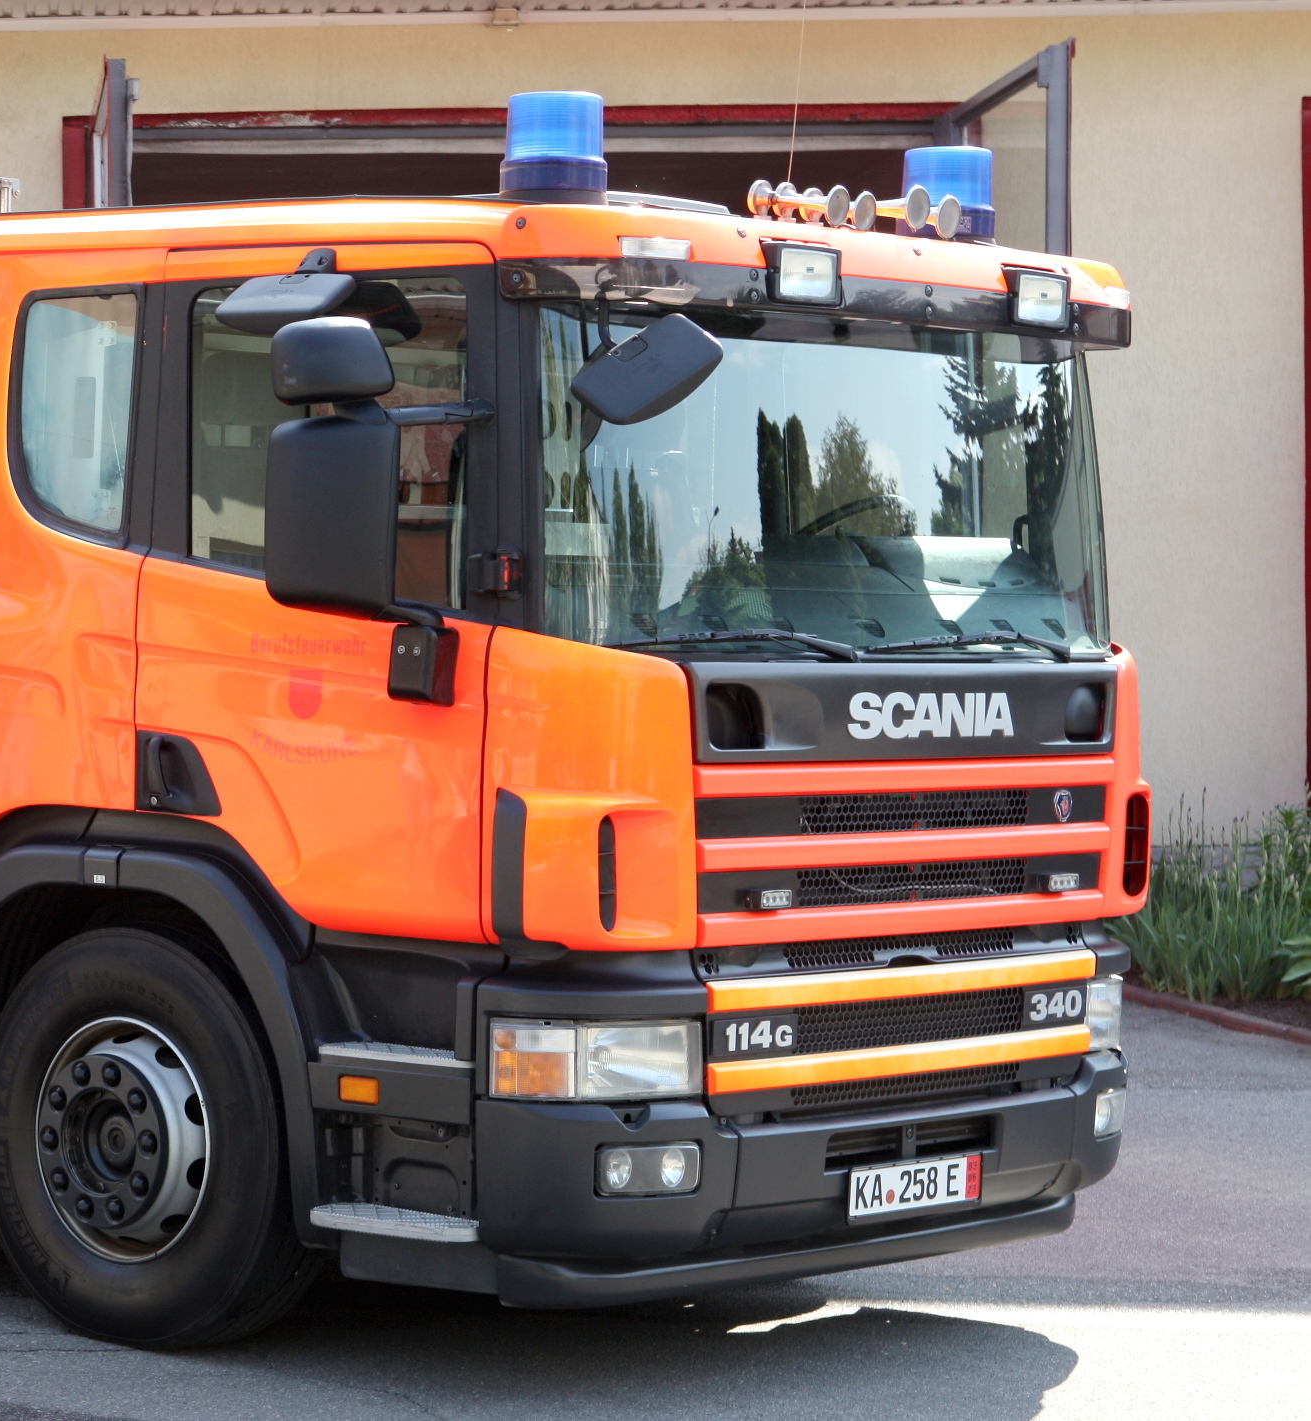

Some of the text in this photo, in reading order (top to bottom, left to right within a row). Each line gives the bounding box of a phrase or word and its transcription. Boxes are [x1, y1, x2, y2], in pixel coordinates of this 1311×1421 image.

[250, 632, 367, 656] Berufsfeuerwehr
[847, 691, 1015, 740] SCANIA
[250, 728, 359, 764] KARLSRUHE
[1029, 989, 1083, 1022] 340
[855, 1163, 960, 1210] KA 258 E
